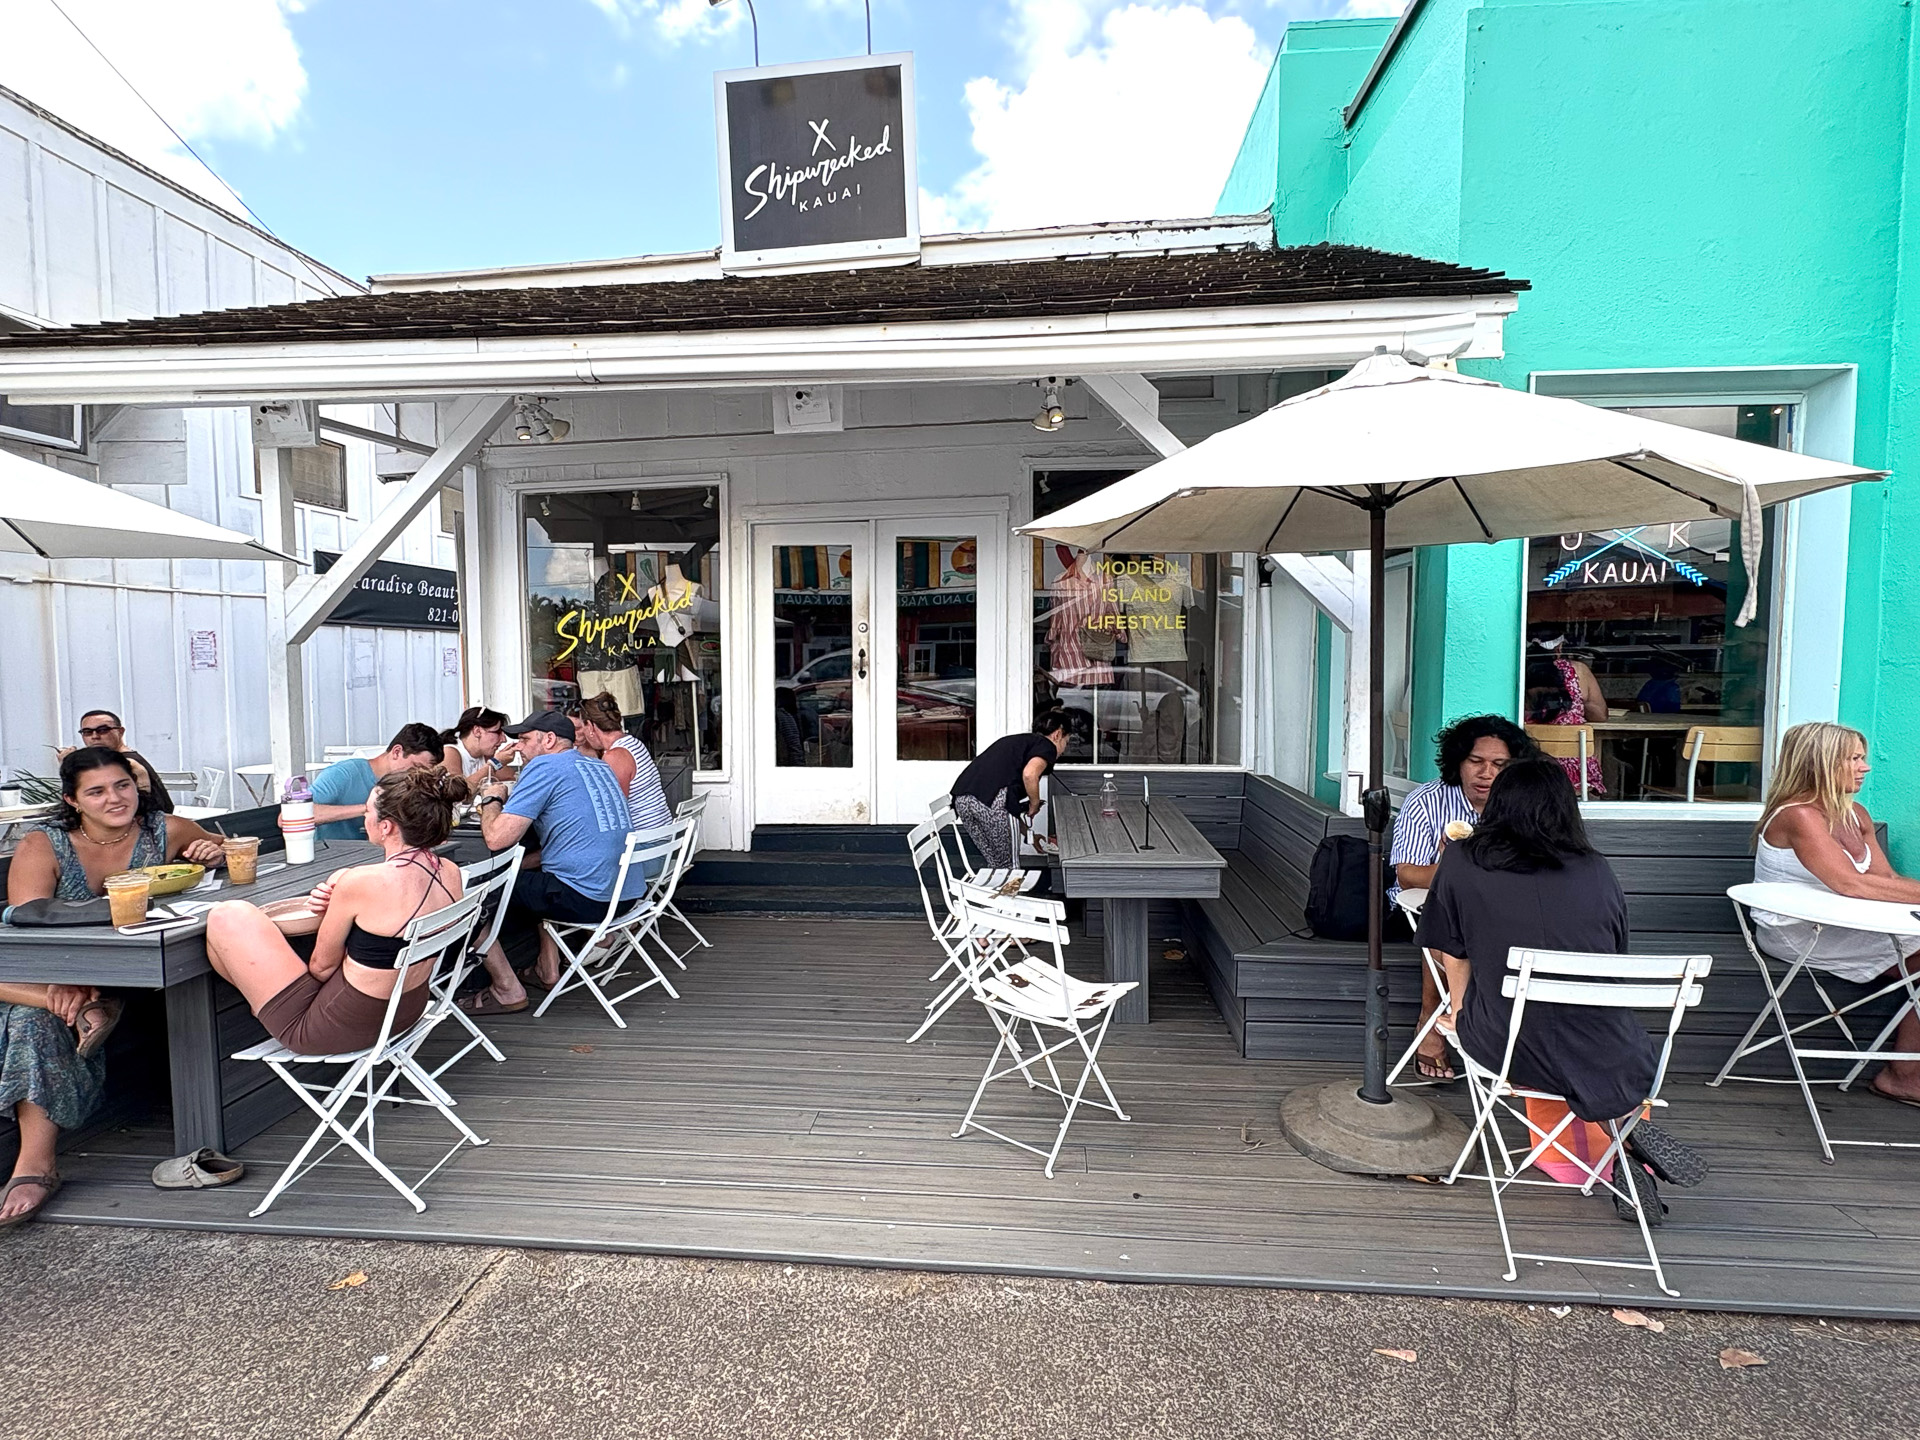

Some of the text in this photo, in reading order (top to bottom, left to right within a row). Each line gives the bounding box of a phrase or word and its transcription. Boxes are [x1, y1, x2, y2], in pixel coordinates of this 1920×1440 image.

[744, 124, 892, 221] Shipwrecked
[799, 183, 861, 213] KAUAI
[1096, 560, 1179, 575] MODERN
[1583, 561, 1667, 584] KAUAI
[1102, 587, 1172, 603] ISLAND
[556, 581, 693, 661] Shipwrecked
[1087, 615, 1187, 630] LIFESTYLE
